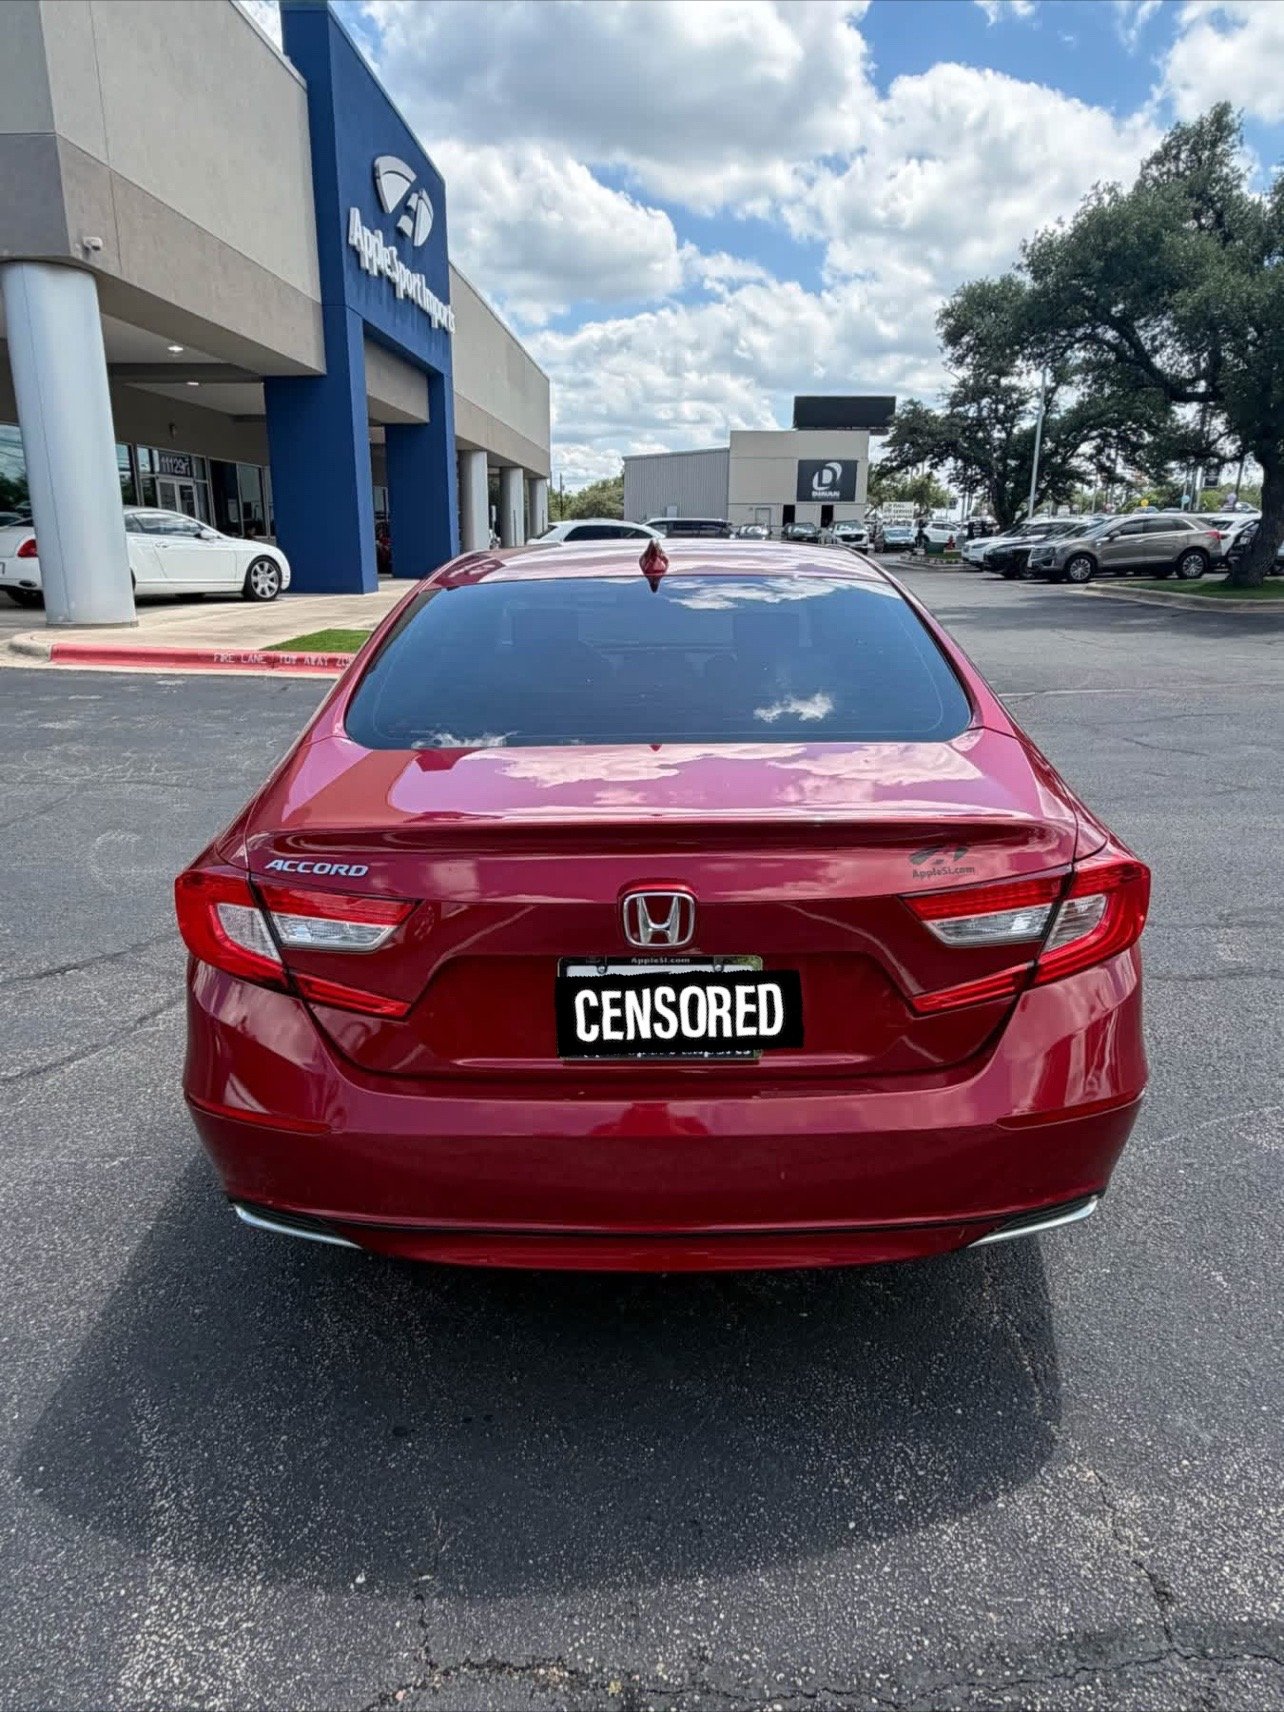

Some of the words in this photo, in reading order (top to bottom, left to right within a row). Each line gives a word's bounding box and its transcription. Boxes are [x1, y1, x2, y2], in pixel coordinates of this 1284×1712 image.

[213, 654, 235, 663] FIRE
[240, 655, 267, 664] LANE
[303, 657, 328, 666] AWAY
[265, 859, 369, 877] ACCORD
